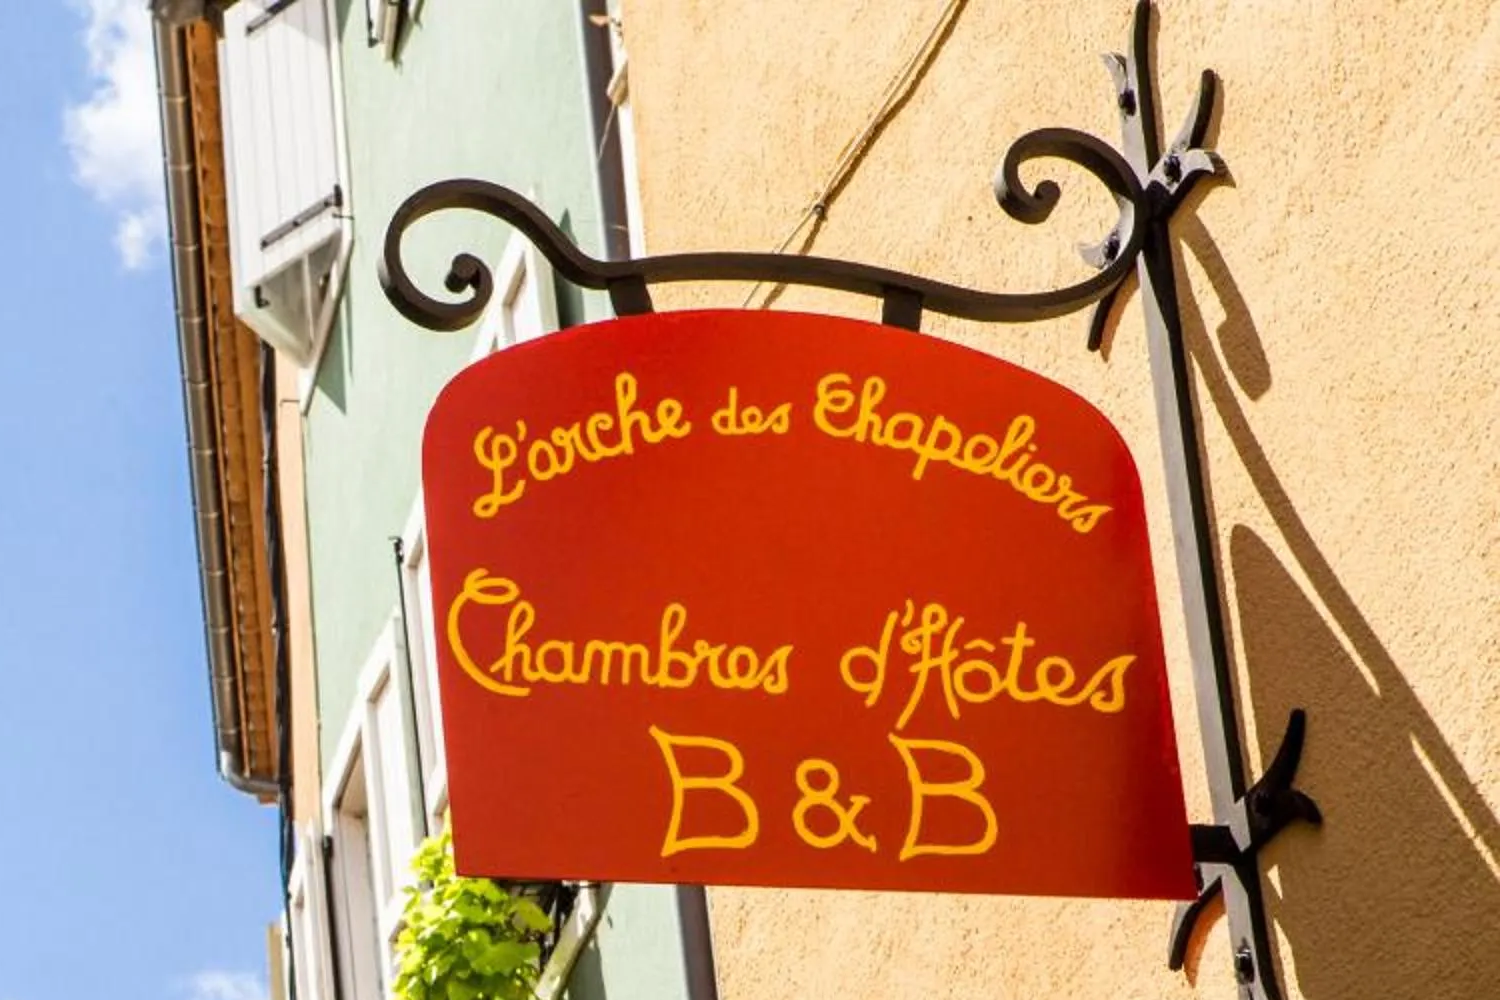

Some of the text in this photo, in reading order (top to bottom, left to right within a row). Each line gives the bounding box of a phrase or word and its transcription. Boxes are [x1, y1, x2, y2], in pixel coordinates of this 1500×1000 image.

[473, 372, 1112, 533] L'arche des Chapeliers
[447, 567, 1136, 730] Chambres d'Hôtes
[648, 724, 998, 861] B & B
